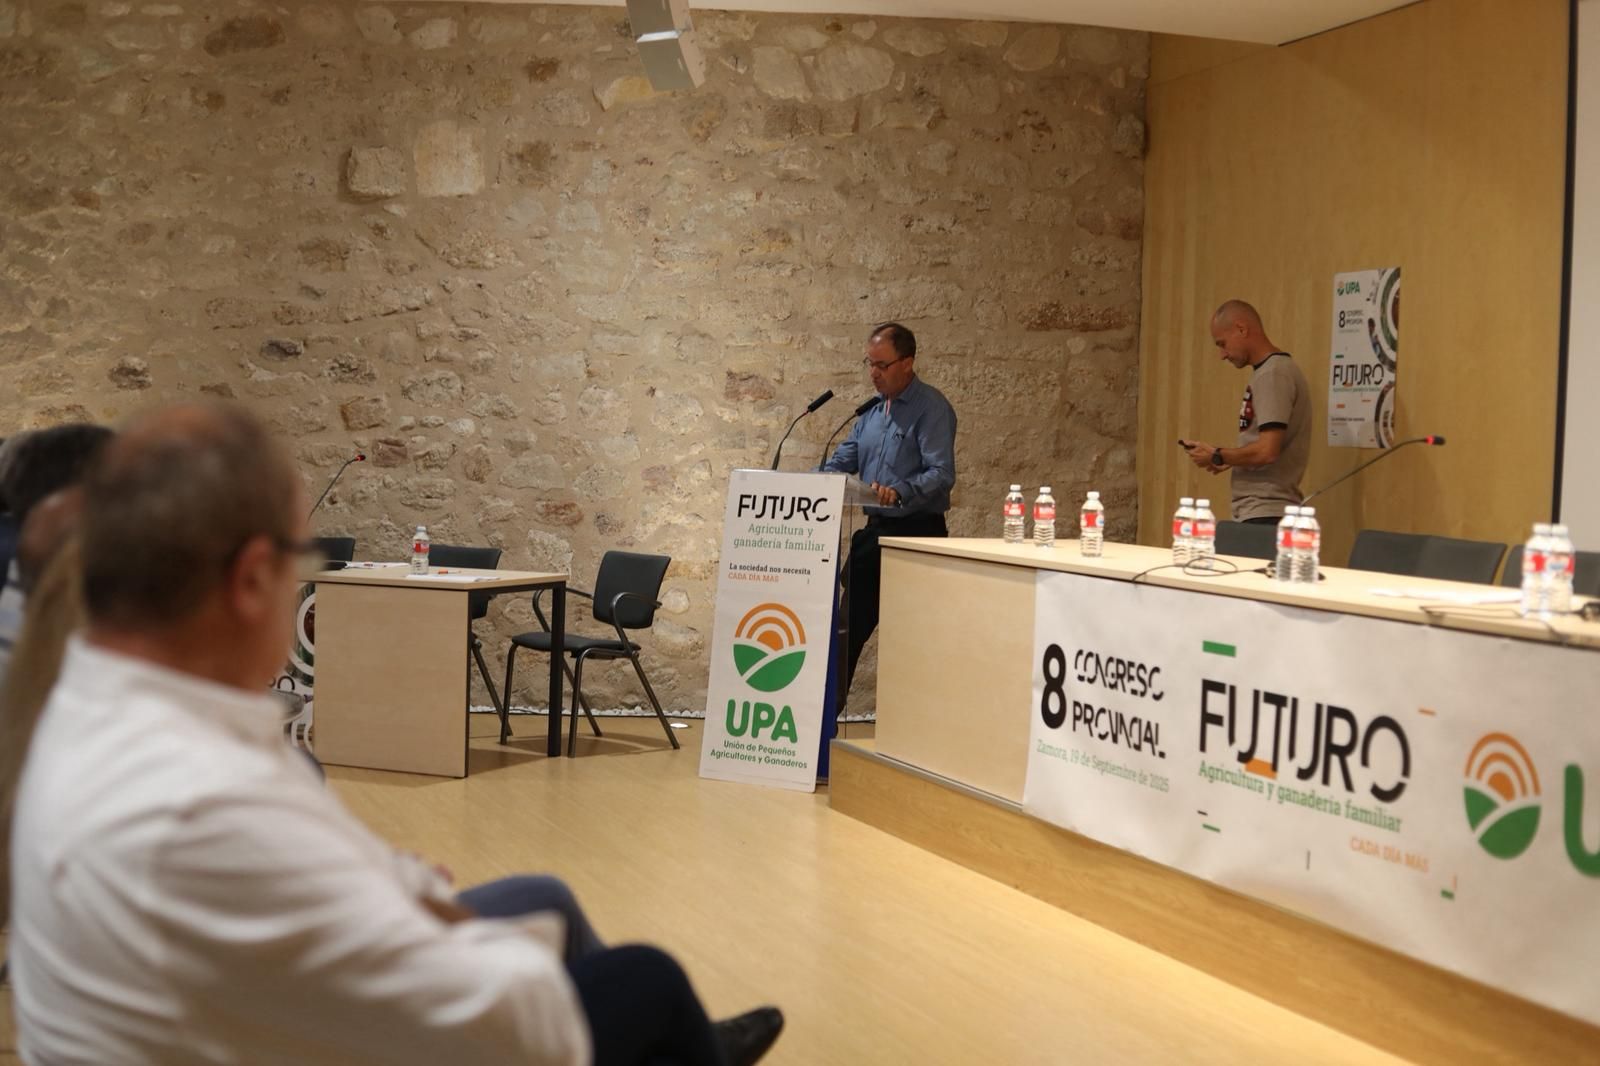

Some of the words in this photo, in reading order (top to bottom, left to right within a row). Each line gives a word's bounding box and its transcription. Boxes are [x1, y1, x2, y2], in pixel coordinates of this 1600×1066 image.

[1345, 282, 1360, 294] UPA
[1338, 310, 1346, 328] 8
[1333, 364, 1384, 386] FUTURO
[748, 523, 804, 536] Agricultura
[807, 528, 814, 538] y
[784, 539, 826, 551] familiar
[729, 562, 737, 570] La
[739, 564, 768, 572] sociedad
[782, 567, 811, 575] necesita
[1041, 643, 1067, 730] 8
[725, 698, 798, 743] UPA
[723, 740, 745, 750] Unión
[746, 743, 757, 751] de
[758, 744, 796, 757] Pequeños
[1200, 678, 1411, 804] FUTURO
[710, 749, 756, 762] Agricultores
[764, 756, 808, 769] Ganaderos
[1199, 760, 1265, 795] Agricultura
[1266, 781, 1275, 801] y
[1344, 799, 1404, 834] familiar
